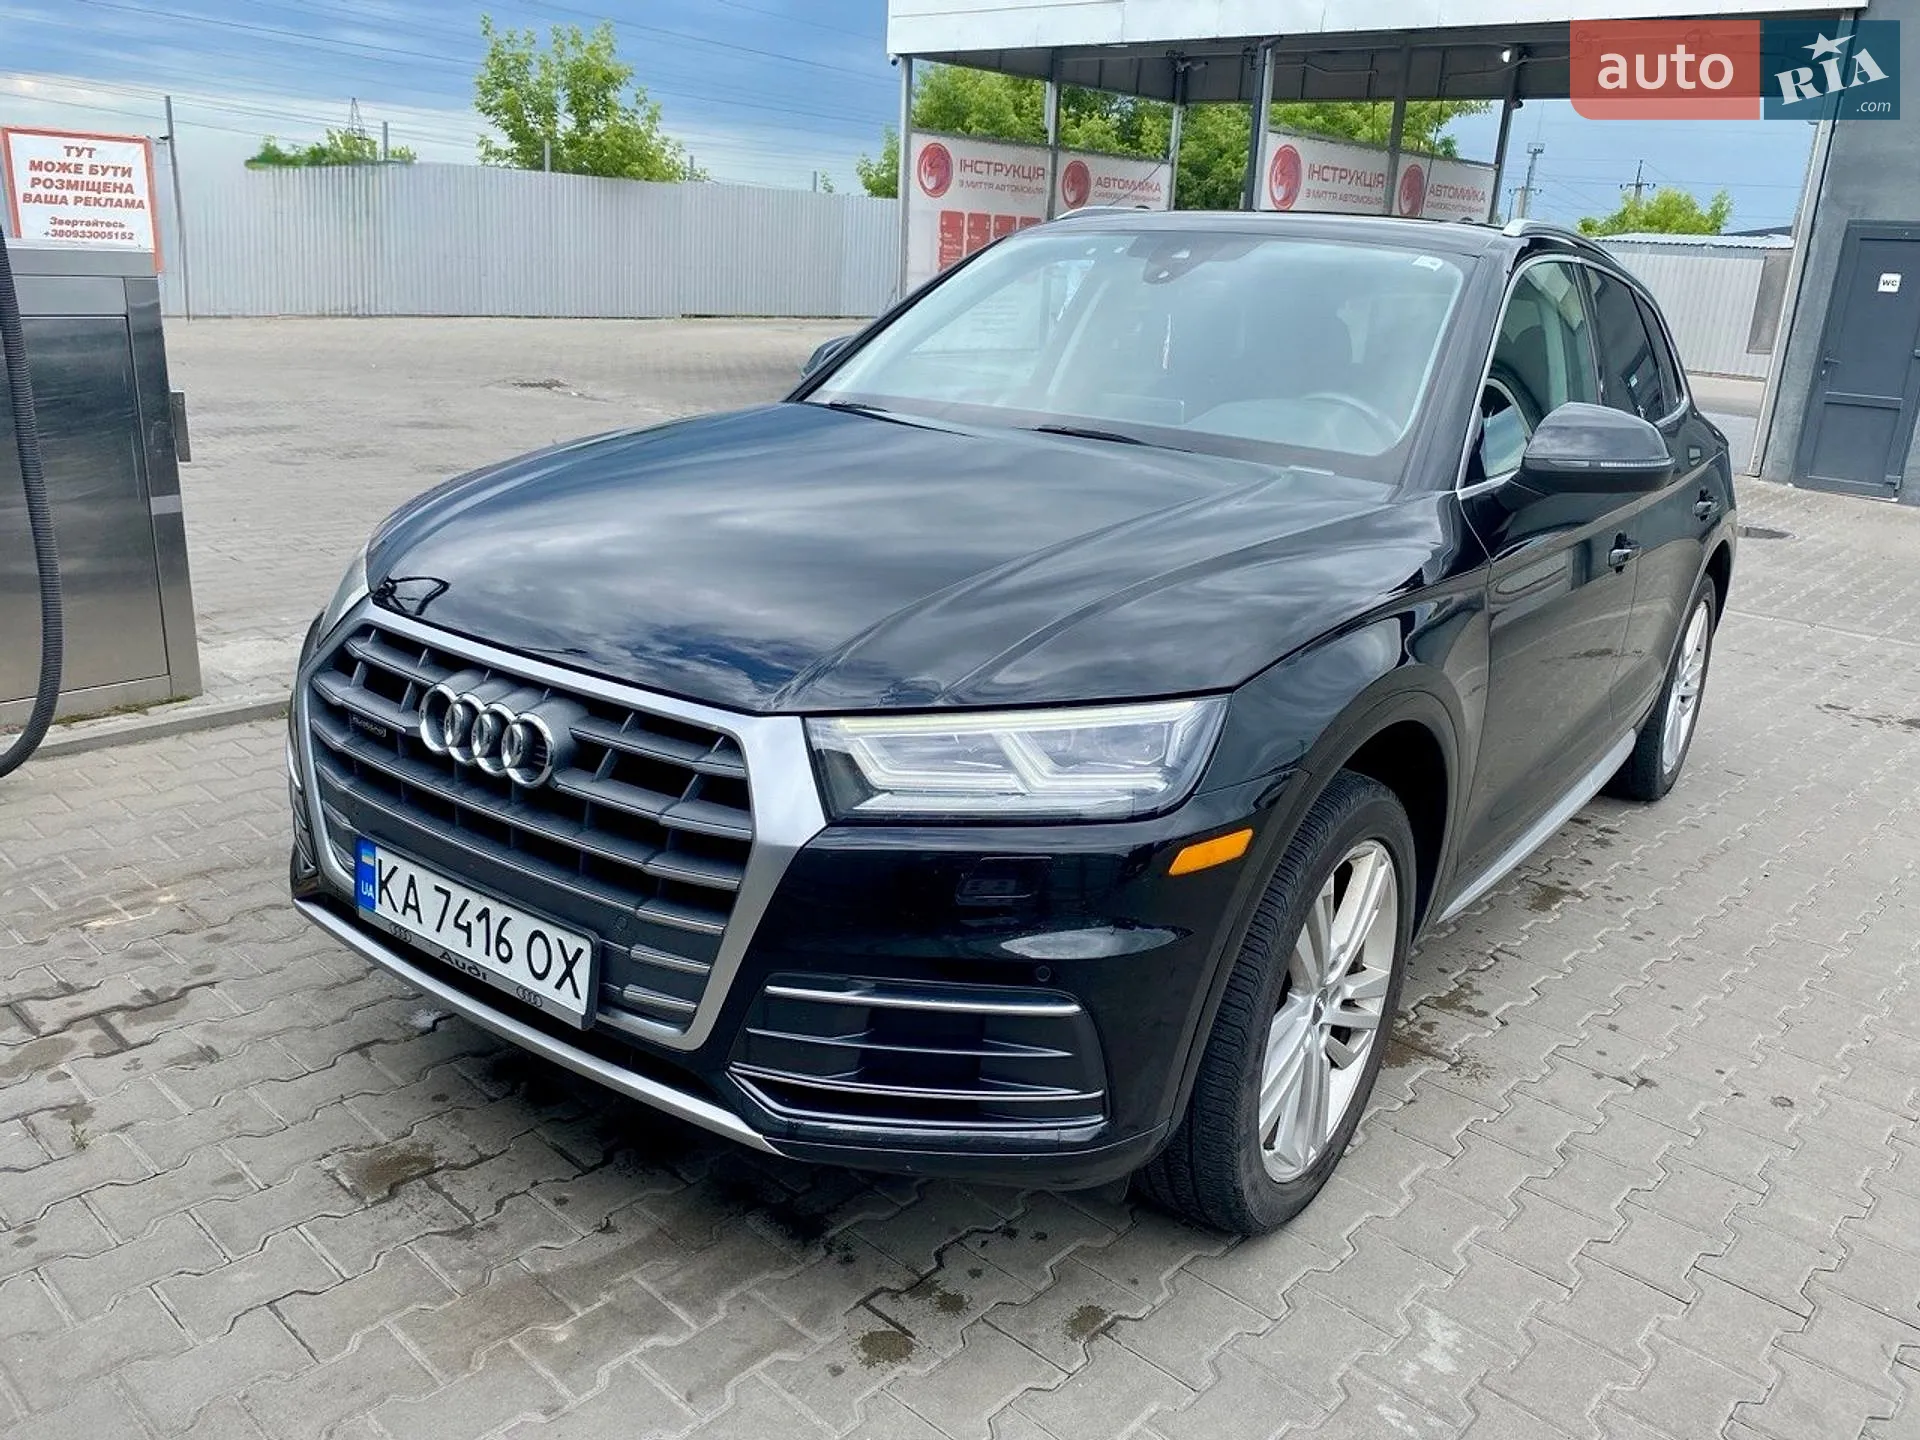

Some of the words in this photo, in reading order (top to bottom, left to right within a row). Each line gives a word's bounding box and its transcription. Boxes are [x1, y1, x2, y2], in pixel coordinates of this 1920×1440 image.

[63, 145, 96, 158] ТУТ
[29, 160, 83, 175] МОЖЕ
[88, 164, 133, 178] БУТИ
[960, 159, 1045, 182] ІНСТРУКЦІЯ
[1308, 163, 1385, 192] ІНСТРУКЦІЯ
[30, 177, 135, 194] РОЗМІЩЕНА
[1096, 176, 1161, 192] АВТОМИЙКА
[1429, 183, 1486, 202] АВТОМИЙКА
[22, 193, 69, 206] ВАША
[73, 196, 145, 209] РЕКЛАМА
[49, 216, 125, 228] Звертайтесь
[44, 229, 135, 240] +380933005152
[361, 880, 375, 899] UA
[378, 858, 423, 924] KA
[433, 884, 513, 964] 7416
[526, 929, 585, 1000] OX
